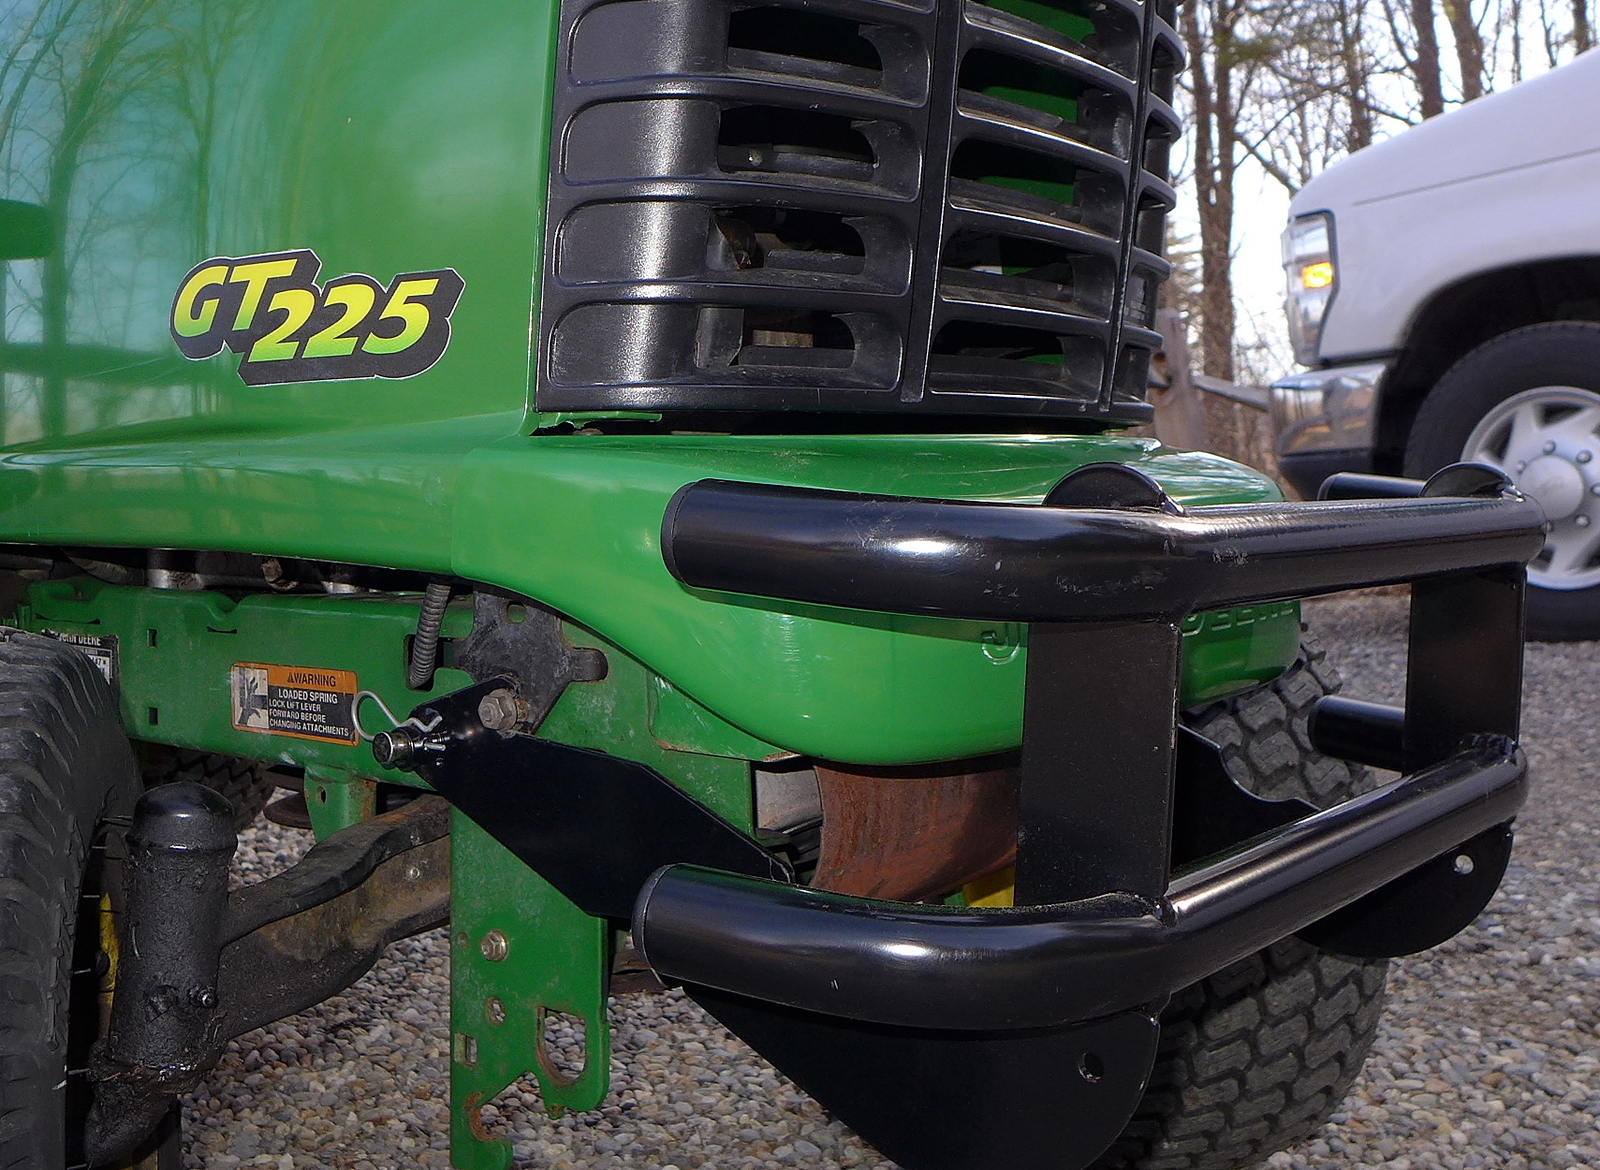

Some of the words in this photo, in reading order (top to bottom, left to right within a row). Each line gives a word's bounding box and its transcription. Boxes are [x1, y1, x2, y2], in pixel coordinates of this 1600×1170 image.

[293, 673, 337, 687] WARNING
[278, 688, 308, 700] LOADED
[309, 691, 338, 704] SPRING
[268, 699, 286, 708] LOCK
[286, 701, 300, 710] LIFT
[300, 703, 321, 712] LEVER
[269, 709, 300, 720] FORWARD
[300, 712, 326, 723] BEFORE
[269, 718, 301, 730] CHANGING
[302, 722, 349, 737] ATTACHMENTS
